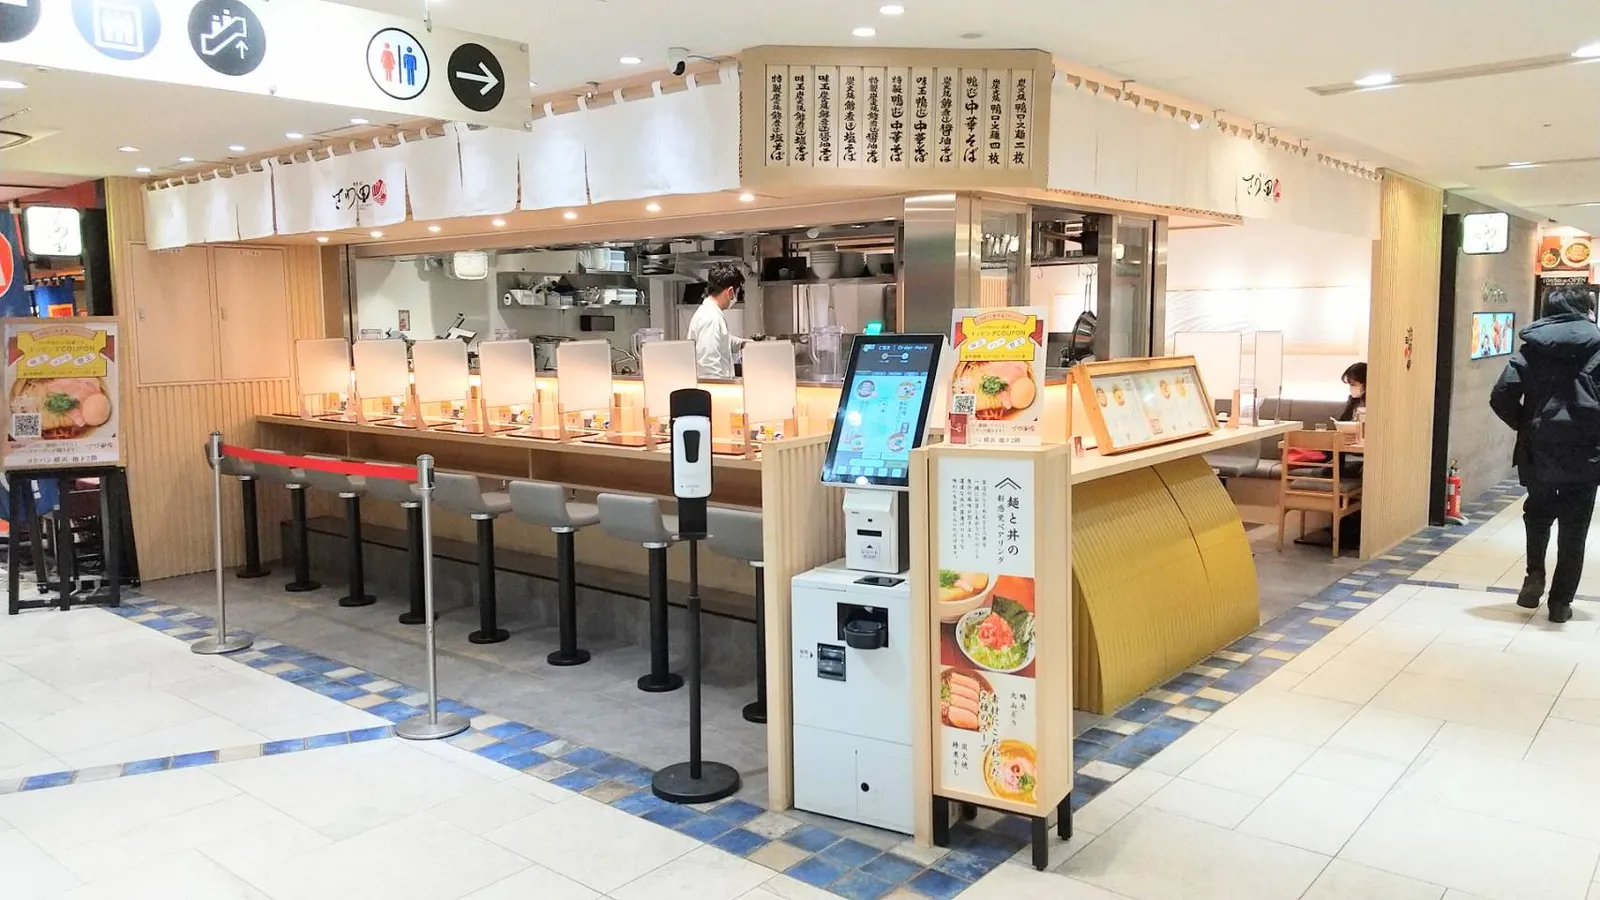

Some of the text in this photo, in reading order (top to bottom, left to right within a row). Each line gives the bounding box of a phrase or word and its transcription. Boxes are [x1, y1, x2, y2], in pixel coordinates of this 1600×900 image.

[914, 76, 928, 163] 味玉鴨だし中華そば
[963, 76, 979, 163] 鴨だし中華そば
[997, 494, 1006, 564] 新感覚ペアリング
[1007, 495, 1020, 556] 麺と丼の
[979, 692, 989, 753] 2種のスープ
[991, 693, 1001, 780] 素材にこだわった
